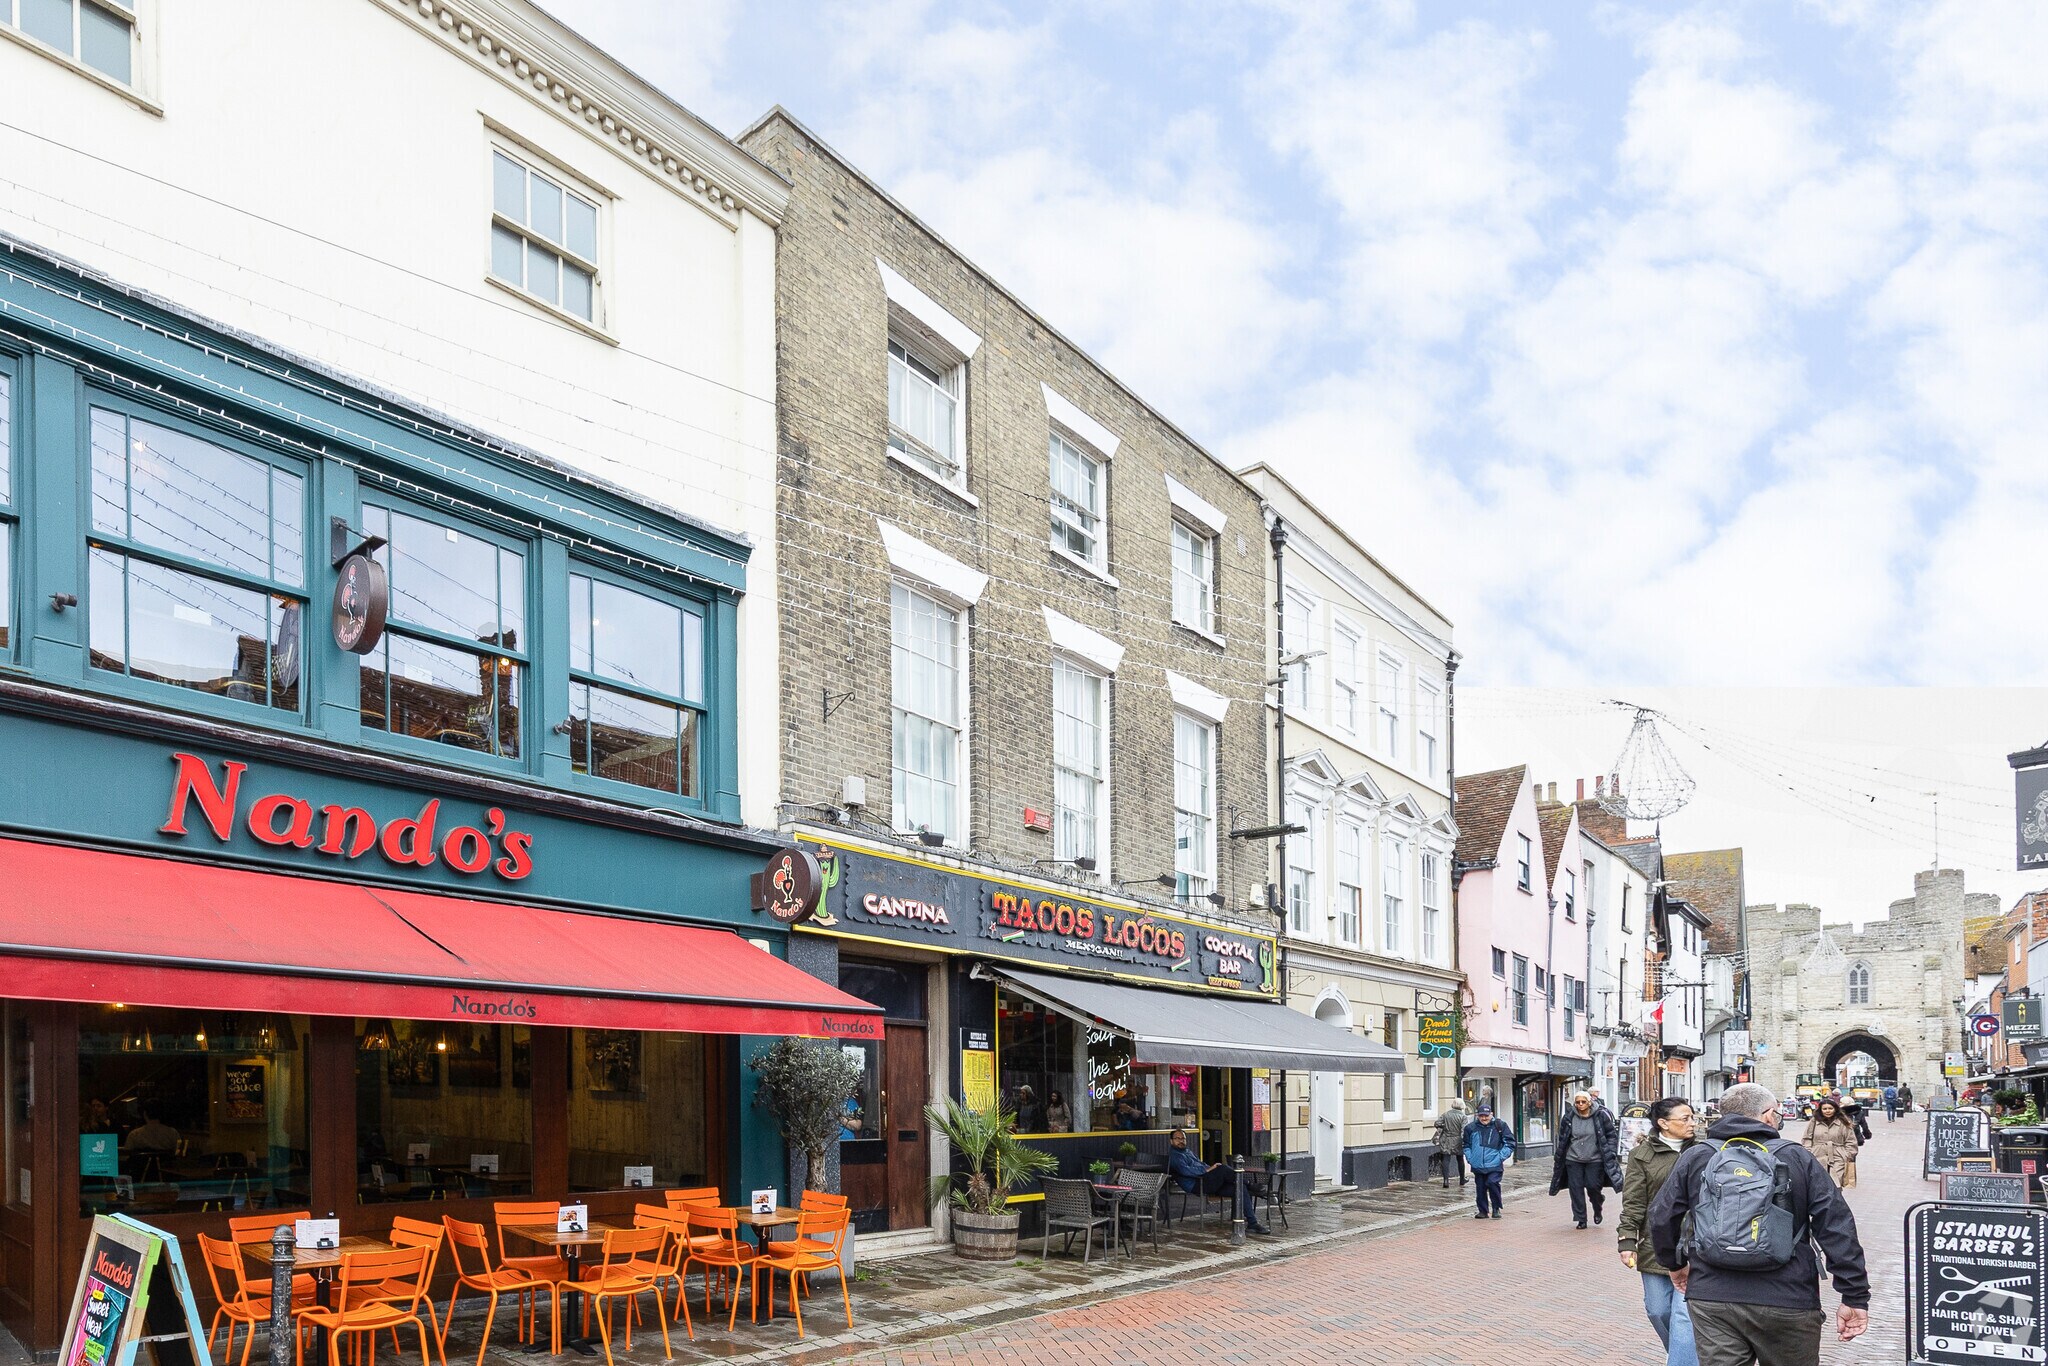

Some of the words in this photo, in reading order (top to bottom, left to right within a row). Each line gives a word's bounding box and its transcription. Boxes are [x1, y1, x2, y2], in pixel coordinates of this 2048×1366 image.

[157, 752, 533, 880] Nando's
[770, 898, 804, 917] Nando's
[863, 893, 949, 924] CANTINA
[993, 891, 1094, 938] TACOS
[1103, 912, 1185, 959] LOCOS
[1065, 940, 1123, 957] MEXICAN!!
[1219, 957, 1242, 975] BAR
[451, 995, 537, 1018] Nando's
[821, 1017, 875, 1034] Nando's
[1423, 1017, 1451, 1028] David
[1420, 1027, 1453, 1038] Grimes
[227, 1083, 262, 1092] sauce
[230, 1077, 246, 1085] got
[1938, 1129, 1968, 1141] HOUSE
[1939, 1139, 1966, 1149] LAGER
[1957, 1176, 1969, 1184] THE
[1973, 1177, 1990, 1185] LADY
[1949, 1186, 1969, 1197] FOOD
[1971, 1187, 1998, 1199] SERVED
[2000, 1188, 2019, 1199] DAILY
[1934, 1221, 2032, 1241] ISTANBUL
[1933, 1236, 2015, 1256] BARBER
[2021, 1242, 2035, 1256] 2
[94, 1250, 134, 1289] Nando's
[1931, 1255, 1976, 1266] TRADITIONAL
[1977, 1258, 2007, 1268] TURKISH
[2008, 1260, 2037, 1270] BARBER
[87, 1297, 110, 1318] Sweet
[85, 1315, 103, 1337] Heat
[1931, 1308, 1959, 1320] HAIR
[1960, 1311, 1985, 1322] CUT
[1986, 1313, 1997, 1324] &
[1998, 1314, 2038, 1327] SHAVE
[1951, 1322, 1975, 1333] HOT
[1976, 1324, 2017, 1337] TOWEL
[1935, 1338, 2034, 1359] OPEN
